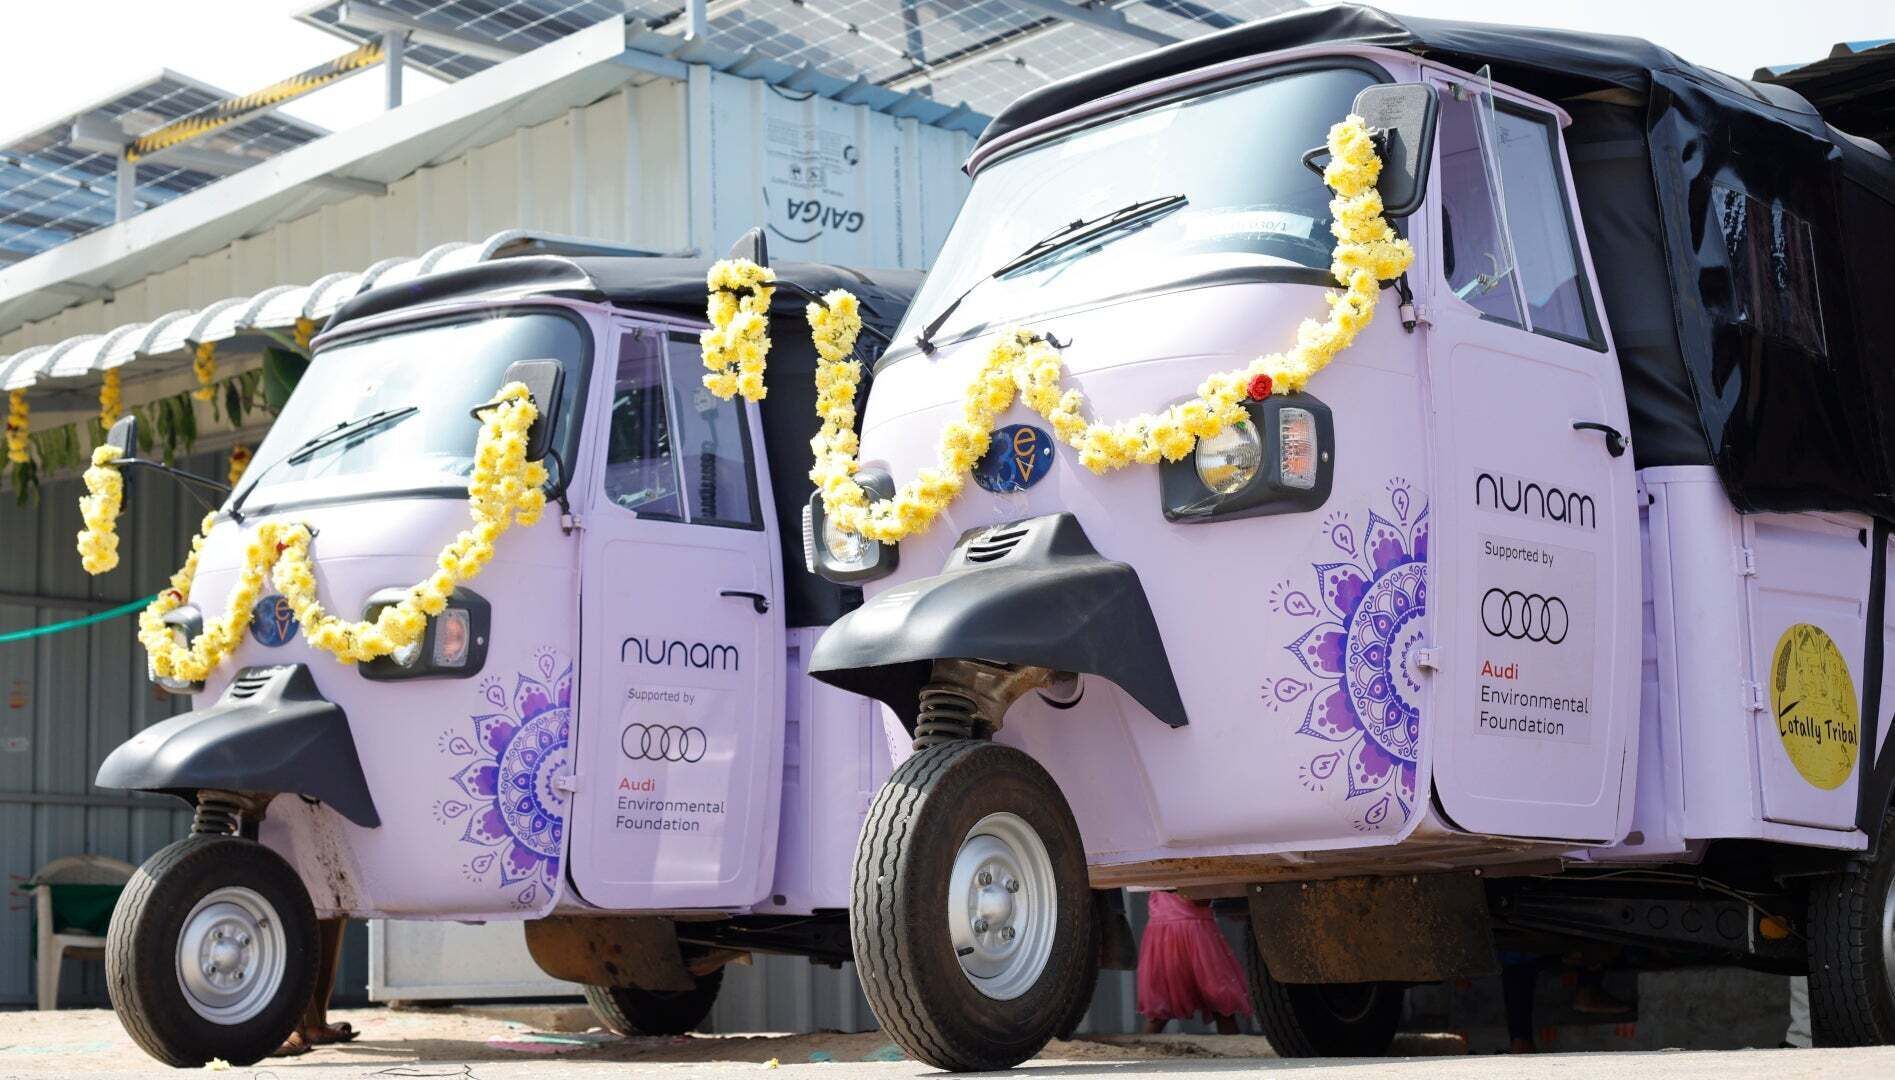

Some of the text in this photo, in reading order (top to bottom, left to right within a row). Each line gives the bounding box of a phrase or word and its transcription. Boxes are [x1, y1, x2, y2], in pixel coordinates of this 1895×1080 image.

[1476, 473, 1596, 529] nunam
[1485, 541, 1554, 568] Supported by
[621, 637, 739, 671] nunam
[1481, 660, 1519, 680] Audi
[628, 688, 695, 704] Supported by
[1481, 685, 1589, 713] Environmental
[1480, 712, 1564, 735] Foundation
[1824, 719, 1858, 745] Tribal
[618, 777, 656, 792] Audi
[617, 796, 725, 814] Environmental
[616, 815, 700, 831] Foundation
